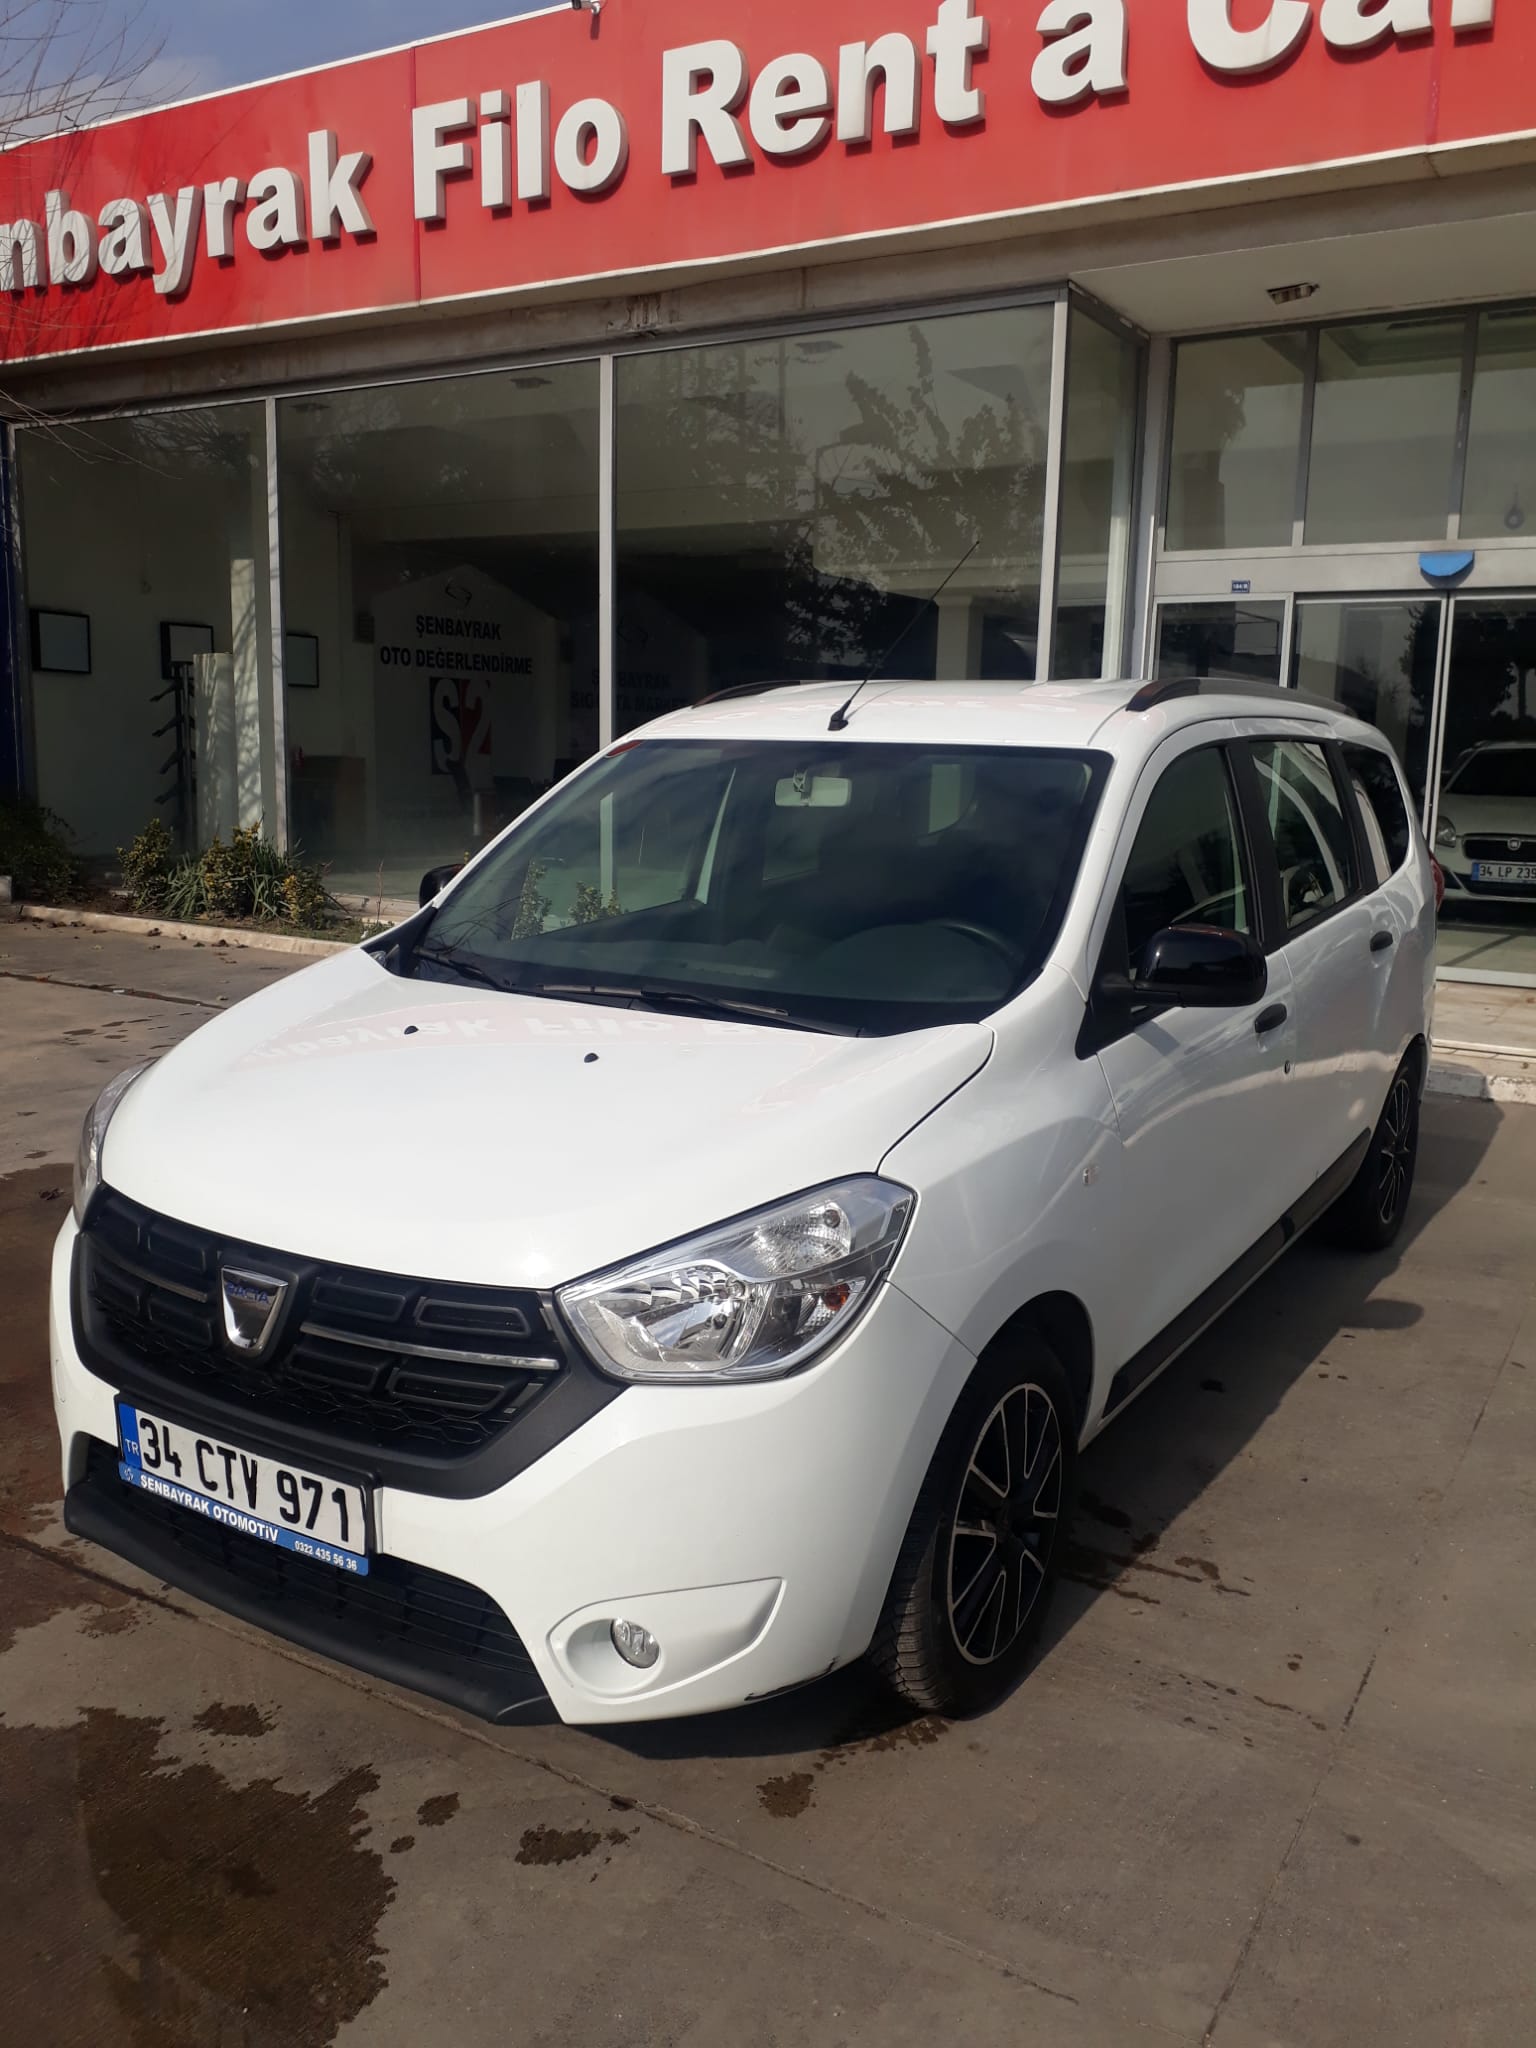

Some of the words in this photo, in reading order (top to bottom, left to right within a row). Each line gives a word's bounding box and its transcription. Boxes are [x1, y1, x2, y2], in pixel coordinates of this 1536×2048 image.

[411, 80, 630, 222] Filo
[661, 0, 990, 177] Rent
[1030, 0, 1129, 106] a
[416, 615, 502, 641] ŞENBAYRAK
[380, 646, 412, 666] OTO
[415, 647, 533, 675] DEĞERLENDİRME
[1480, 865, 1493, 877] 34
[1498, 866, 1513, 878] LP
[125, 1438, 140, 1456] TR
[139, 1417, 182, 1478] 34
[195, 1439, 258, 1510] CTV
[276, 1469, 349, 1543] 971
[315, 1547, 331, 1562] 435
[333, 1553, 344, 1567] 56
